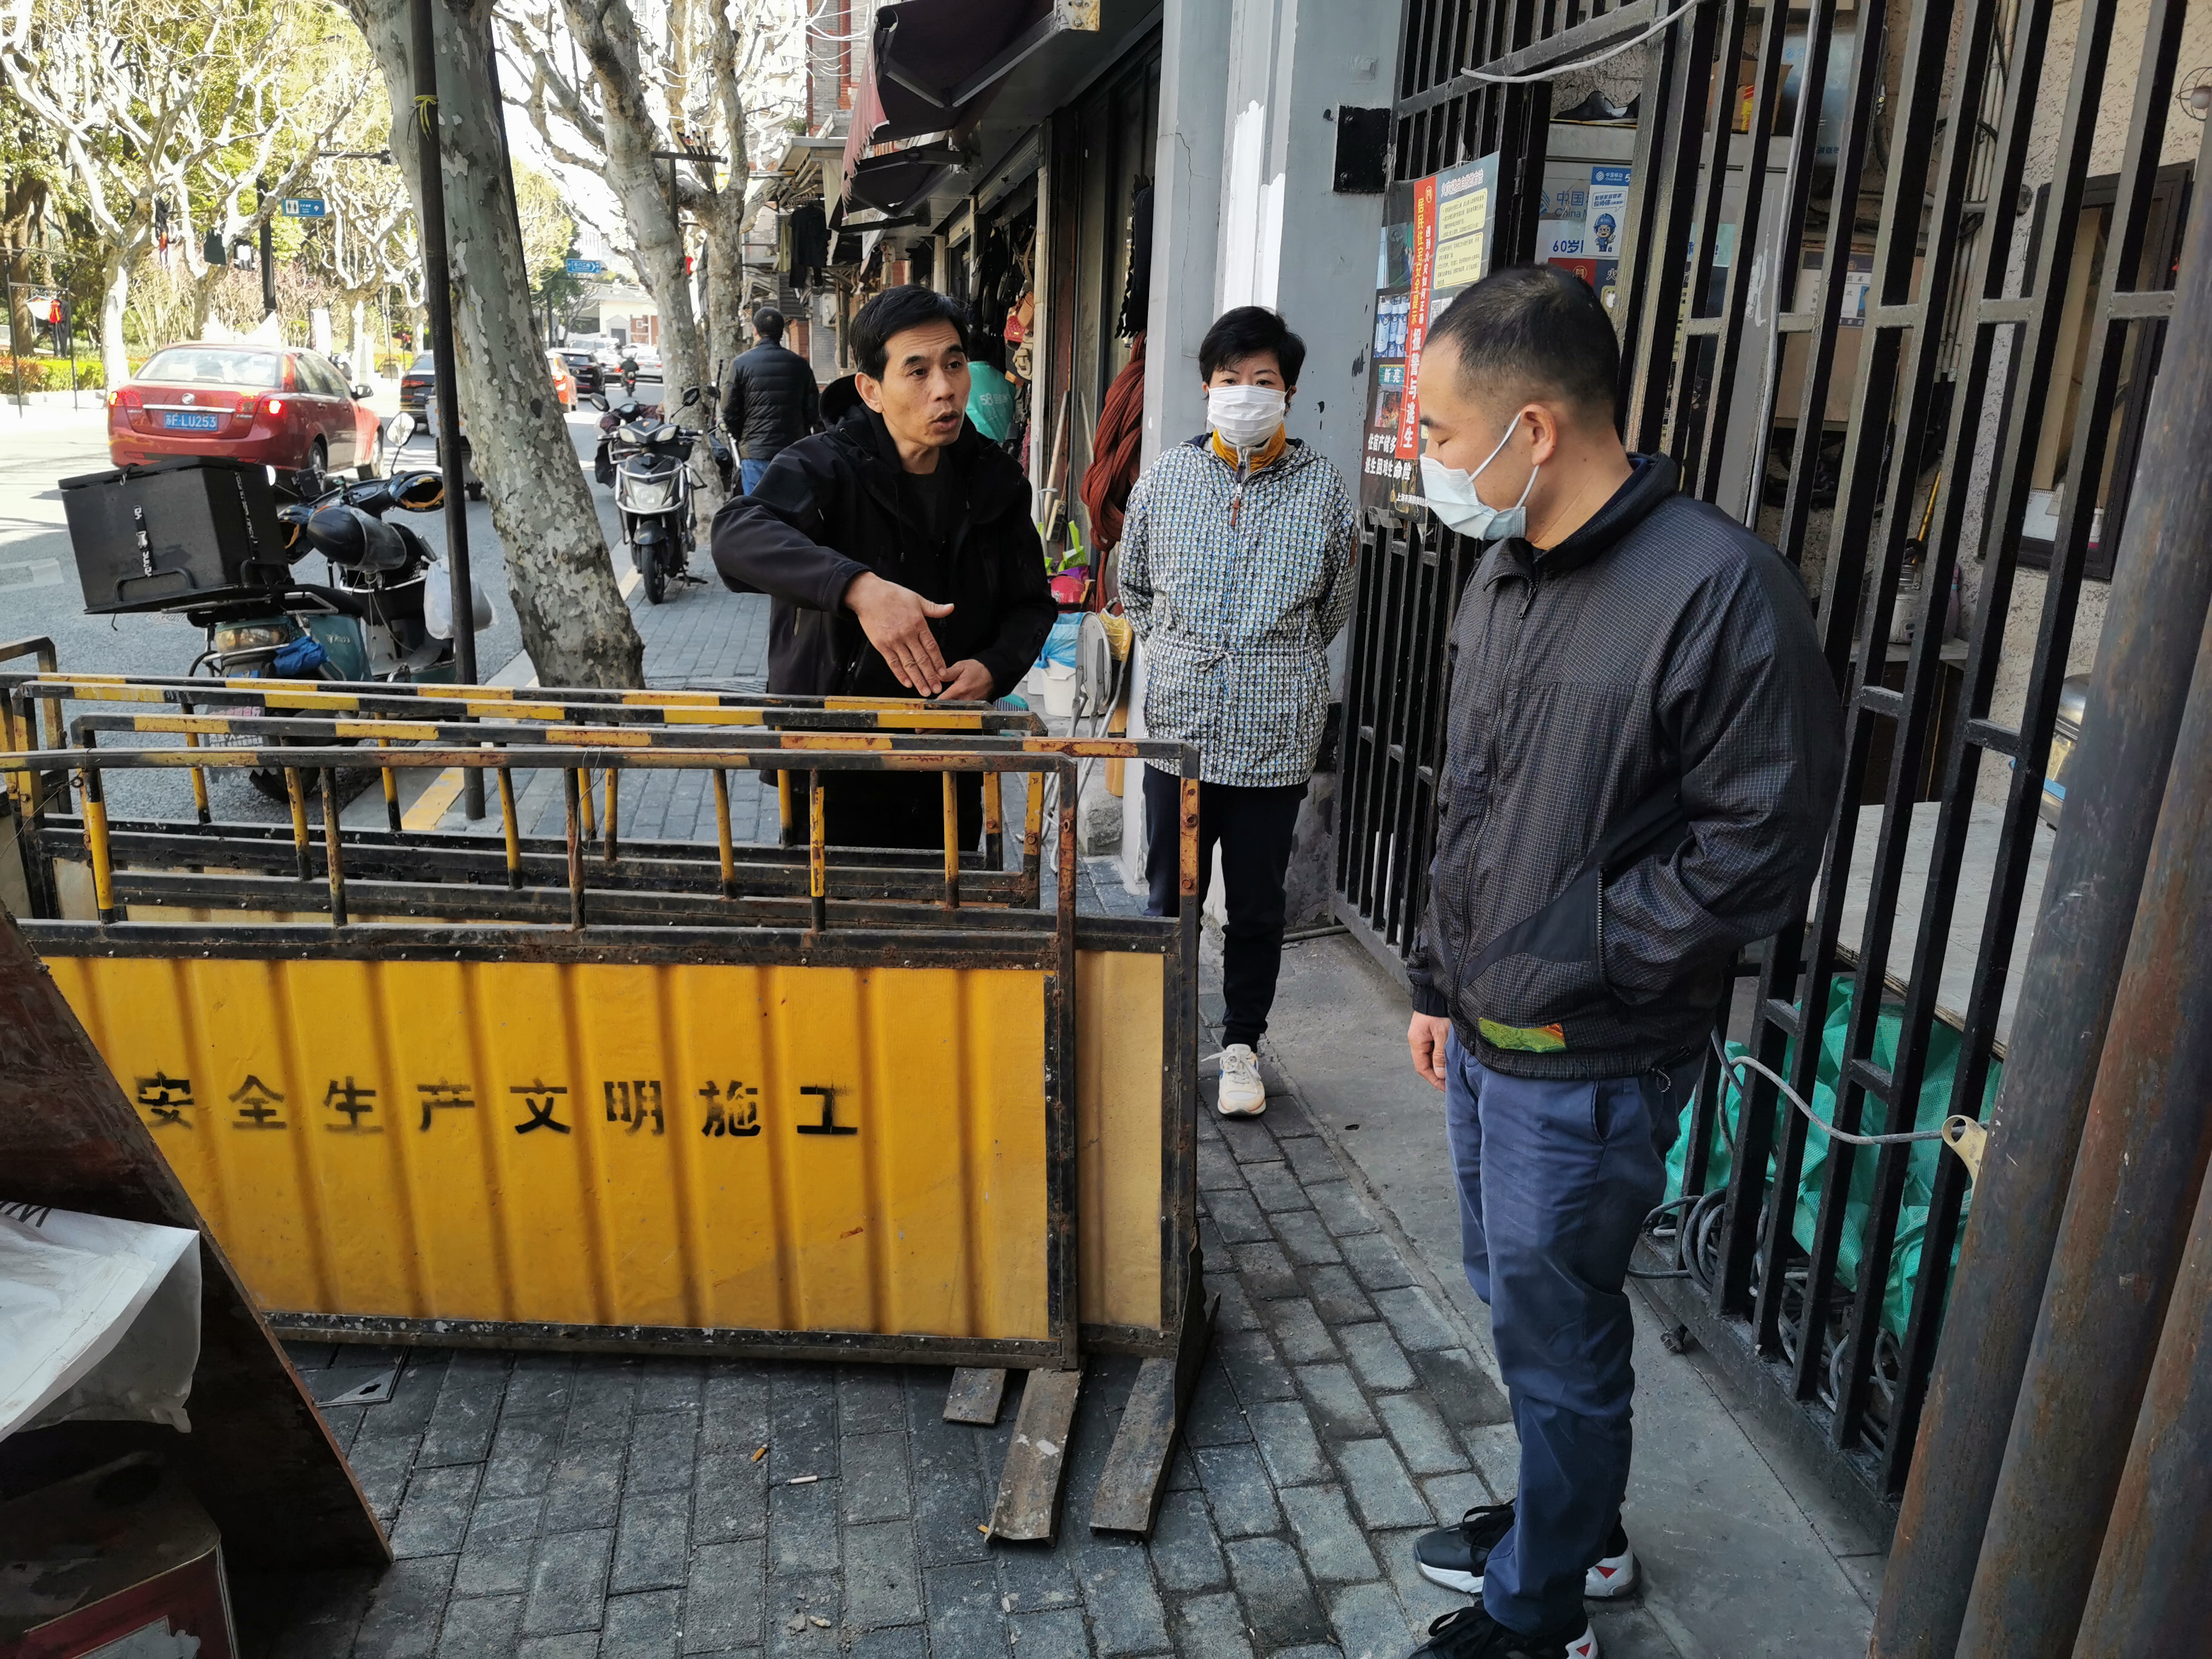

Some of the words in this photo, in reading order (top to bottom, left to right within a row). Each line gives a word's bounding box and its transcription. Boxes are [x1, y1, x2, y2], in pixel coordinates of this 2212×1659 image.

[1555, 208, 1581, 218] China
[1557, 190, 1589, 206] 中国
[1411, 197, 1424, 324] 居民住宅安全提示
[1552, 240, 1584, 253] 60岁
[1403, 328, 1422, 449] 报警与逃生
[135, 1070, 859, 1136] 安全生产文明施工
